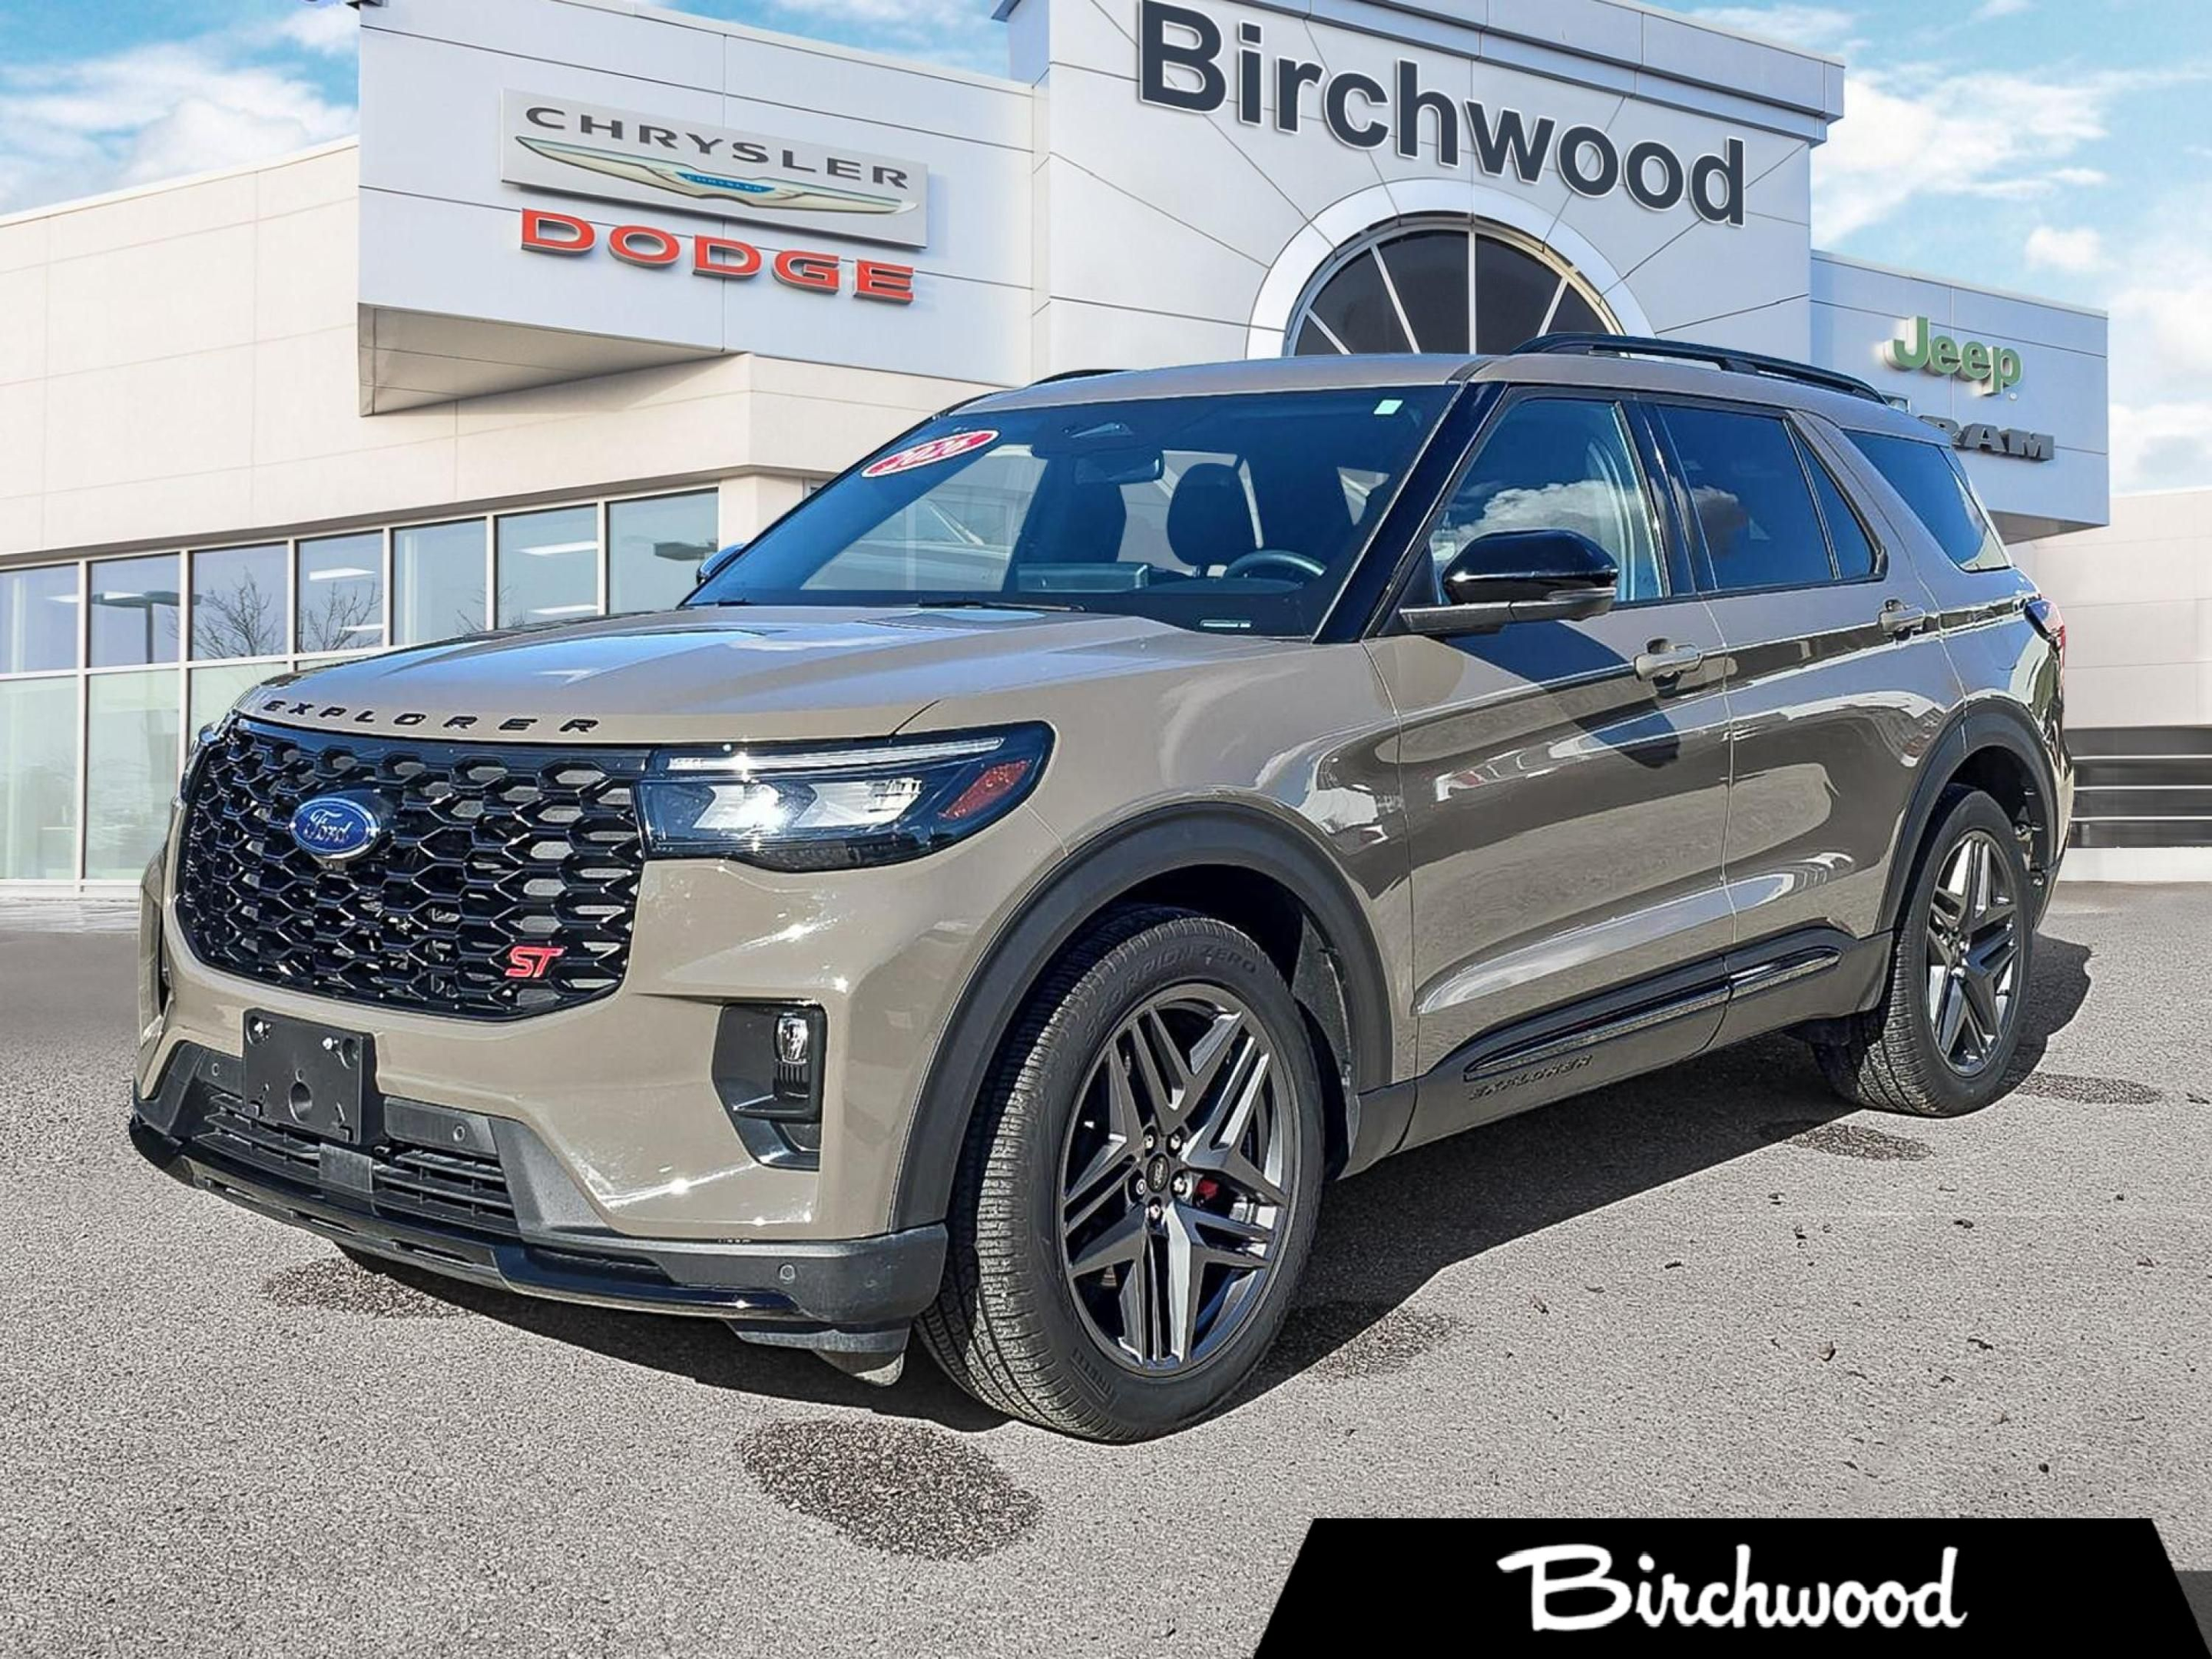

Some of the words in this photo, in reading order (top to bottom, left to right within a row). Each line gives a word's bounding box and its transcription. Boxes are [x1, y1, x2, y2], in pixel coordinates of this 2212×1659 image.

[525, 106, 909, 190] CHRYSLER
[1137, 0, 1747, 228] Birchwood
[520, 207, 916, 304] DODGE
[1883, 316, 2023, 396] Jeep
[263, 700, 599, 733] EXPLORER
[303, 808, 354, 843] Ford
[505, 945, 565, 978] ST
